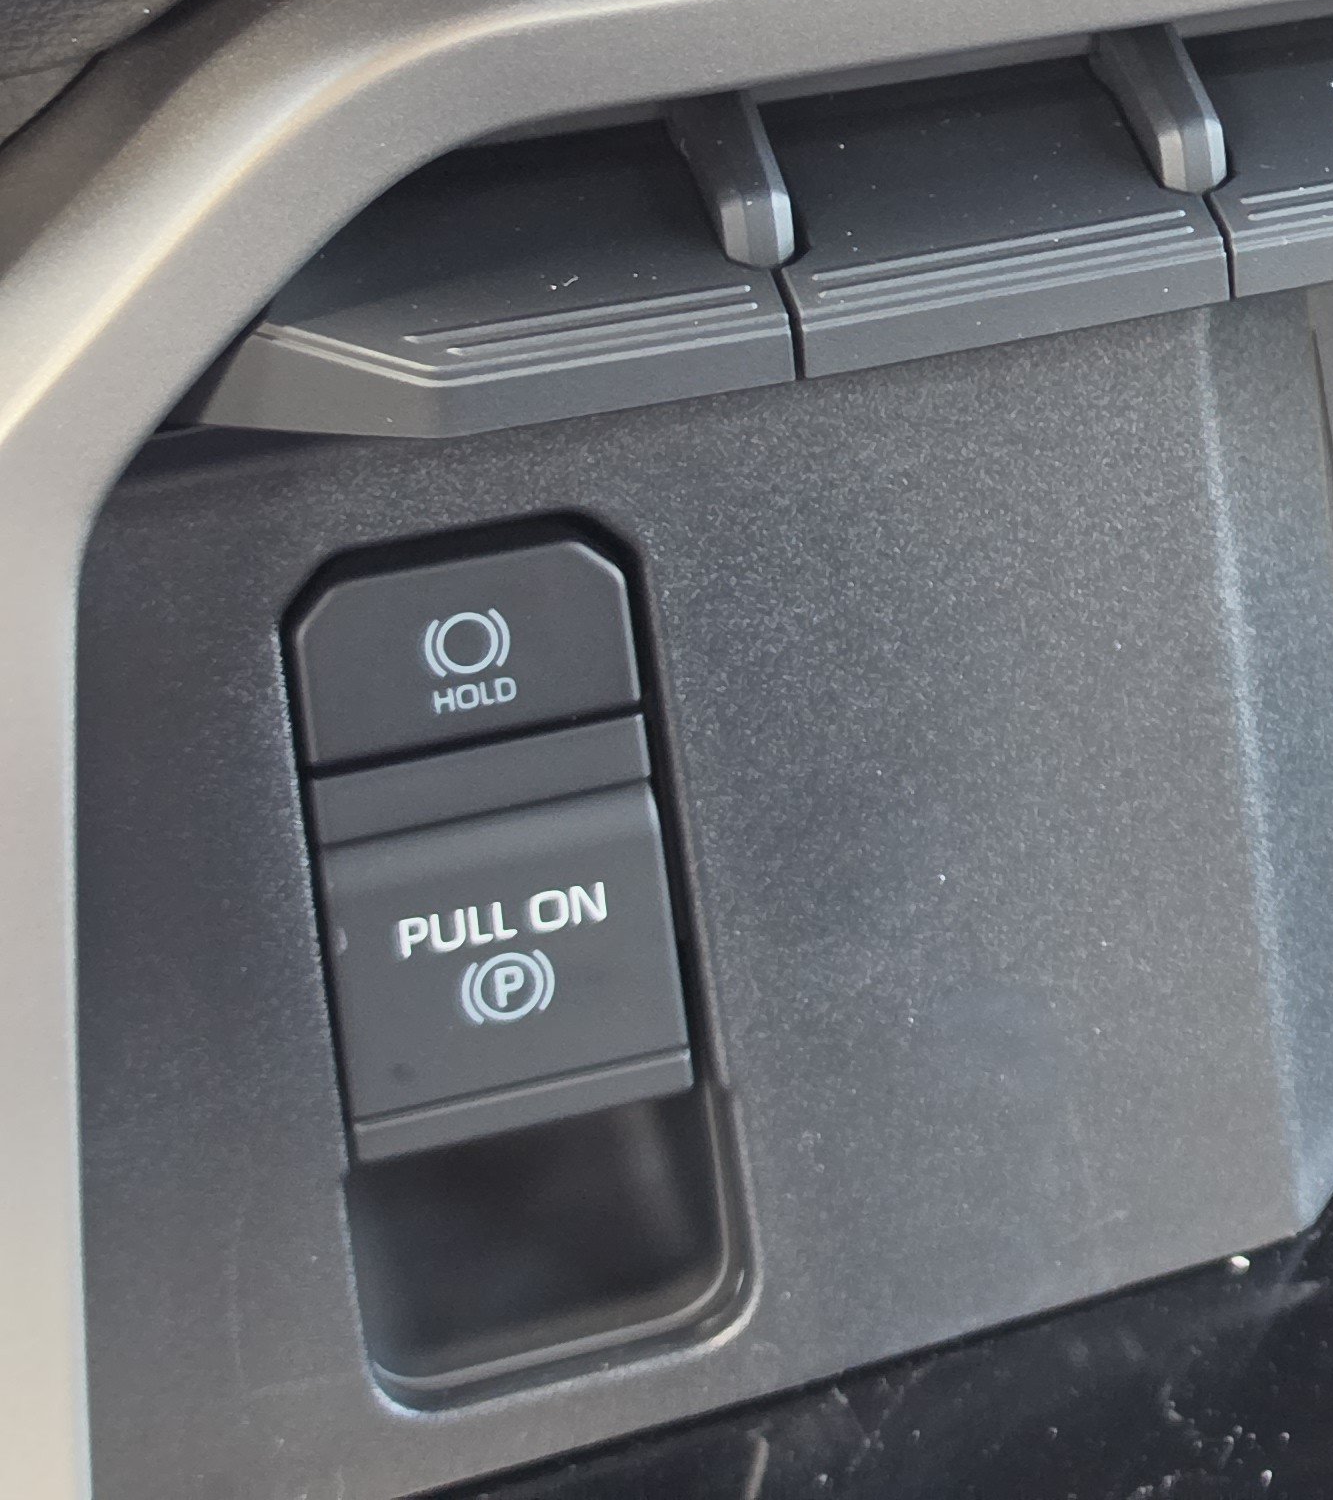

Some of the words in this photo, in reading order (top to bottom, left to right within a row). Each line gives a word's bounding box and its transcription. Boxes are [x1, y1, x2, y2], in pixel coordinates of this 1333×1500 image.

[432, 676, 517, 714] HOLD
[397, 902, 518, 959] PULL
[527, 881, 608, 934] ON
[495, 967, 524, 1008] P
